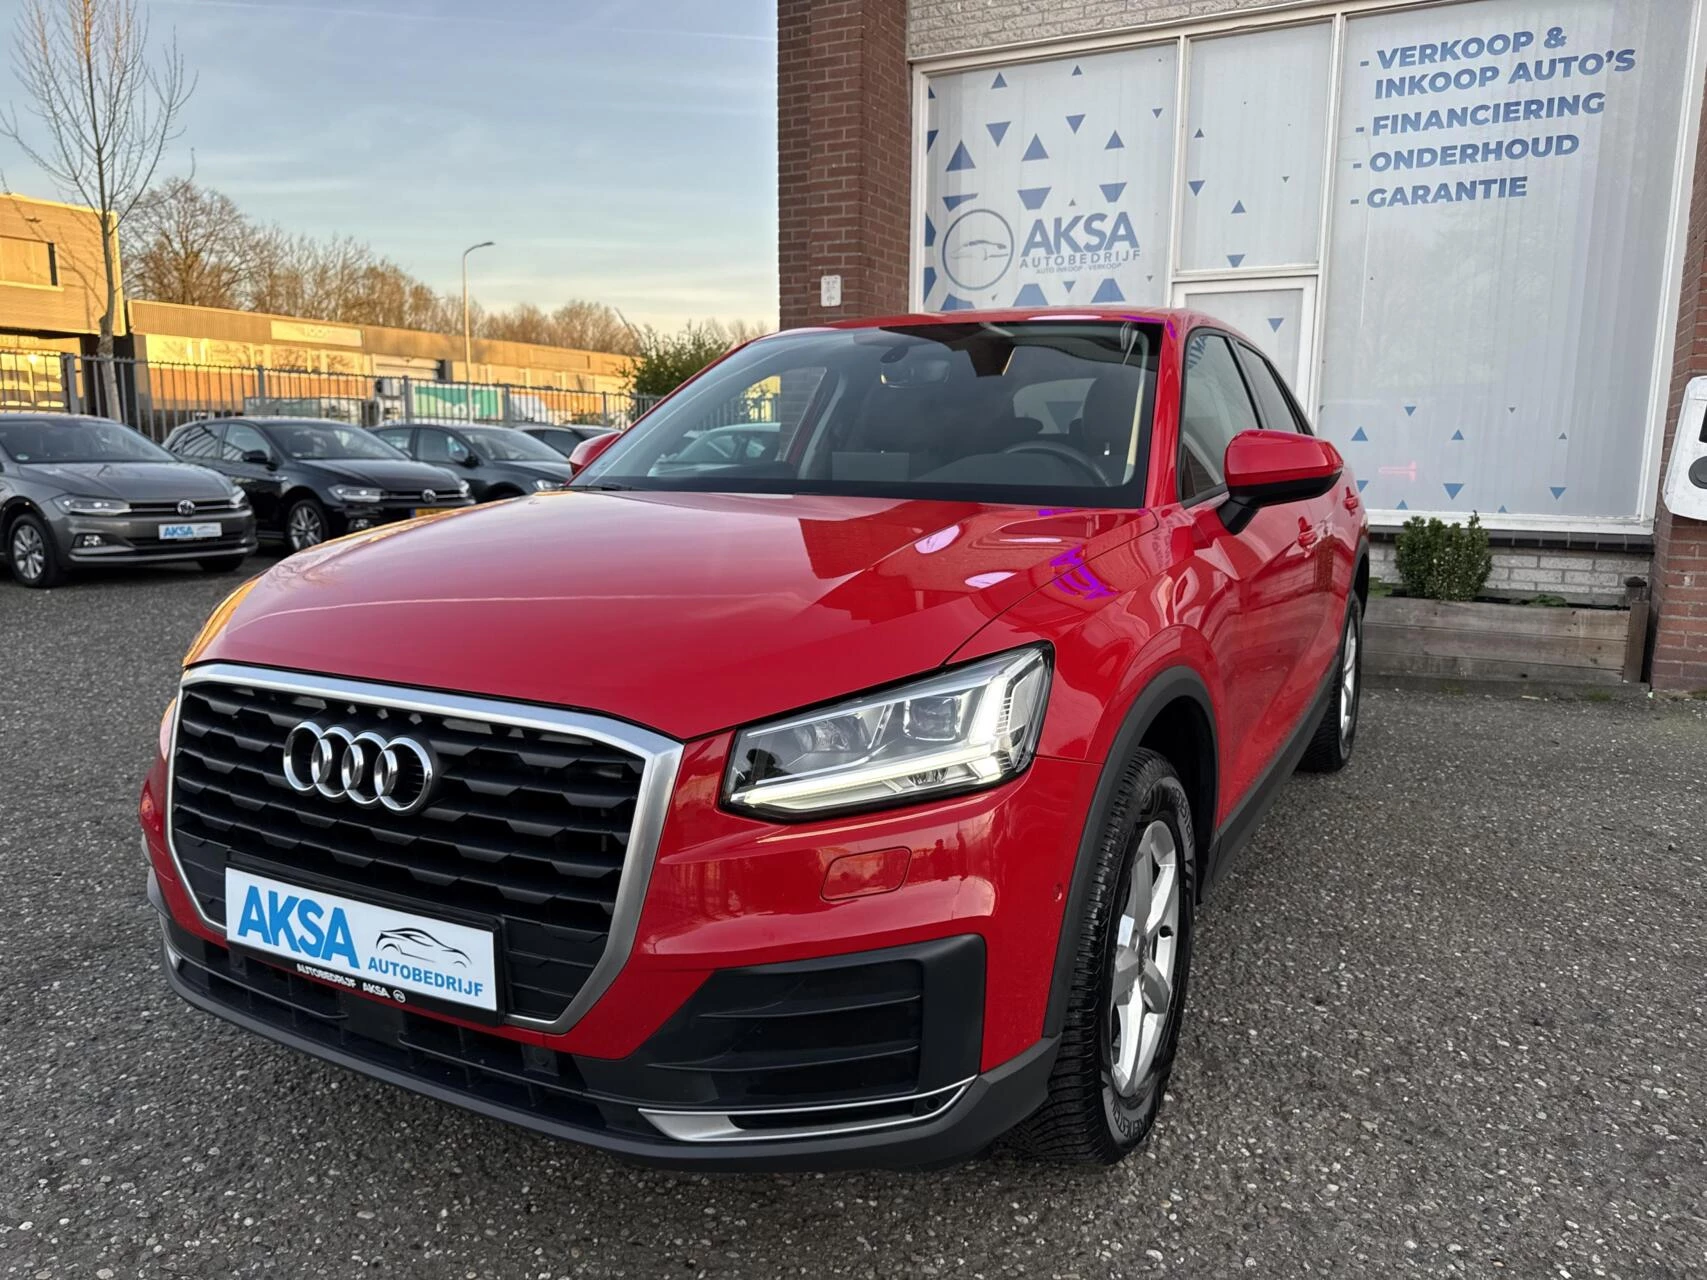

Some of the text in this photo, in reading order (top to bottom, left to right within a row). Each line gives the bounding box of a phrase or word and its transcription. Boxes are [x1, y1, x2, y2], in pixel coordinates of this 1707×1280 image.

[1377, 30, 1534, 70] VERKOOP
[1543, 26, 1567, 49] &
[1374, 49, 1637, 100] INKOOP AUTO'S
[1372, 92, 1606, 137] FINANCIERING
[1369, 134, 1580, 173] ONDERHOUD
[1366, 176, 1528, 209] GARANTIE
[1020, 211, 1140, 257] AKSA
[1020, 250, 1141, 269] AUTOBEDRIJF
[163, 525, 194, 537] AKSA
[237, 885, 360, 970] AKSA
[296, 963, 391, 999] AUTOBEDRIJF AKSA
[368, 956, 484, 998] AUTOBEDRIJF
